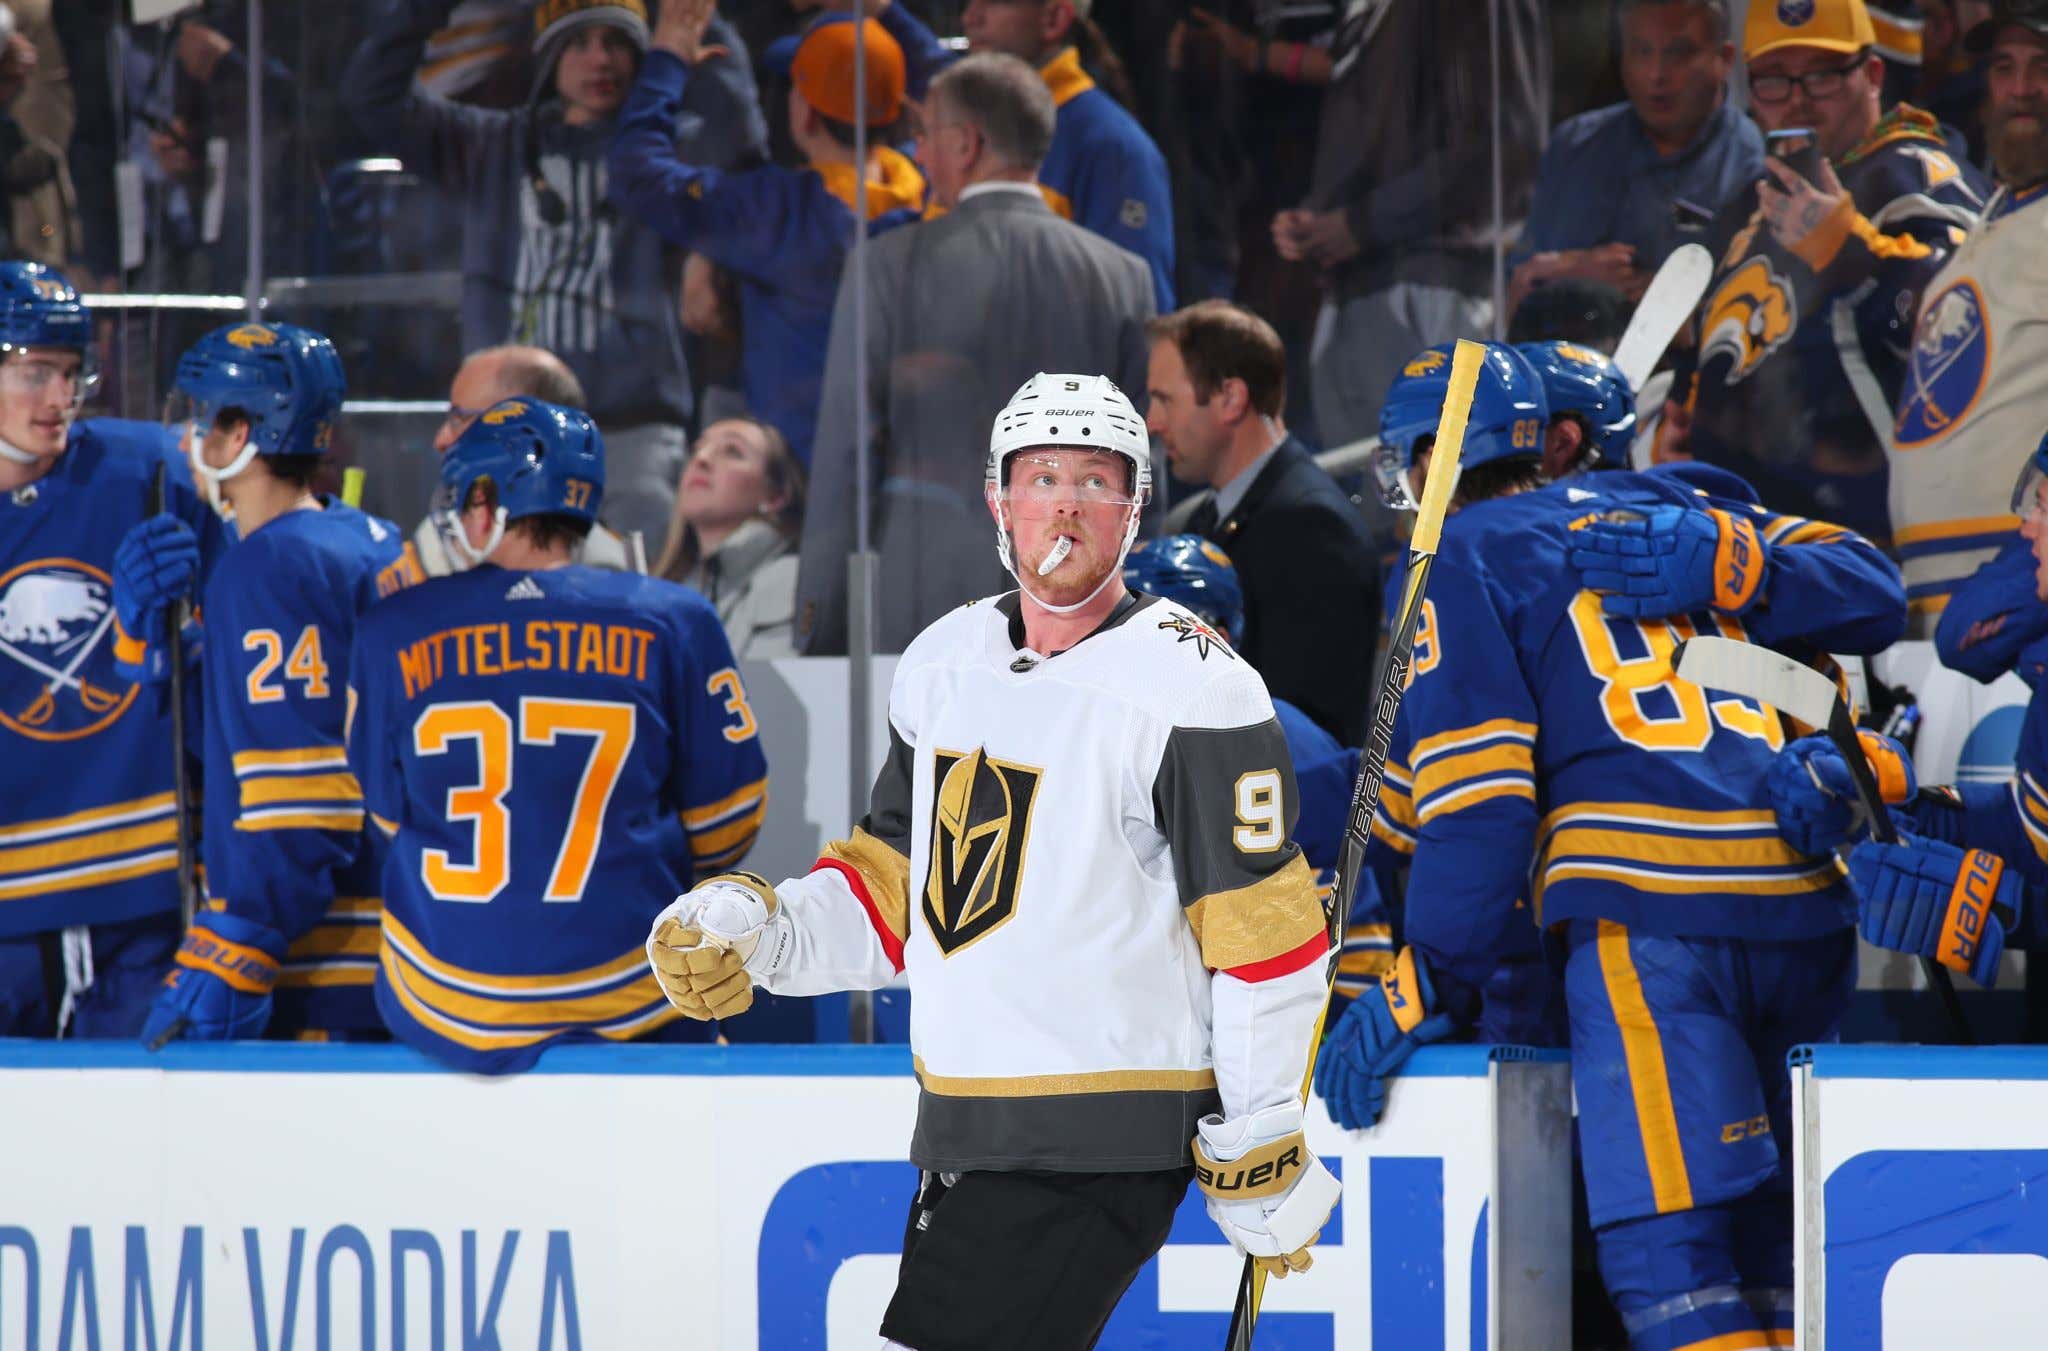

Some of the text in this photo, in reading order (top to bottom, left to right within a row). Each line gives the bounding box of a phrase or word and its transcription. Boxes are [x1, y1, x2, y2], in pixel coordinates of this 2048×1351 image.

[1045, 408, 1095, 417] BAUER
[1512, 418, 1539, 448] 89
[564, 478, 593, 511] 37
[1725, 515, 1750, 595] UER
[242, 623, 331, 704] 24
[398, 620, 656, 700] MITTELSTADT
[1351, 655, 1409, 845] BAUER
[413, 695, 636, 903] 37
[1233, 767, 1285, 853] 9
[1951, 850, 1996, 961] AUER
[1196, 1145, 1301, 1190] AUER
[1721, 1114, 1770, 1143] CC
[242, 1223, 583, 1351] VODKA
